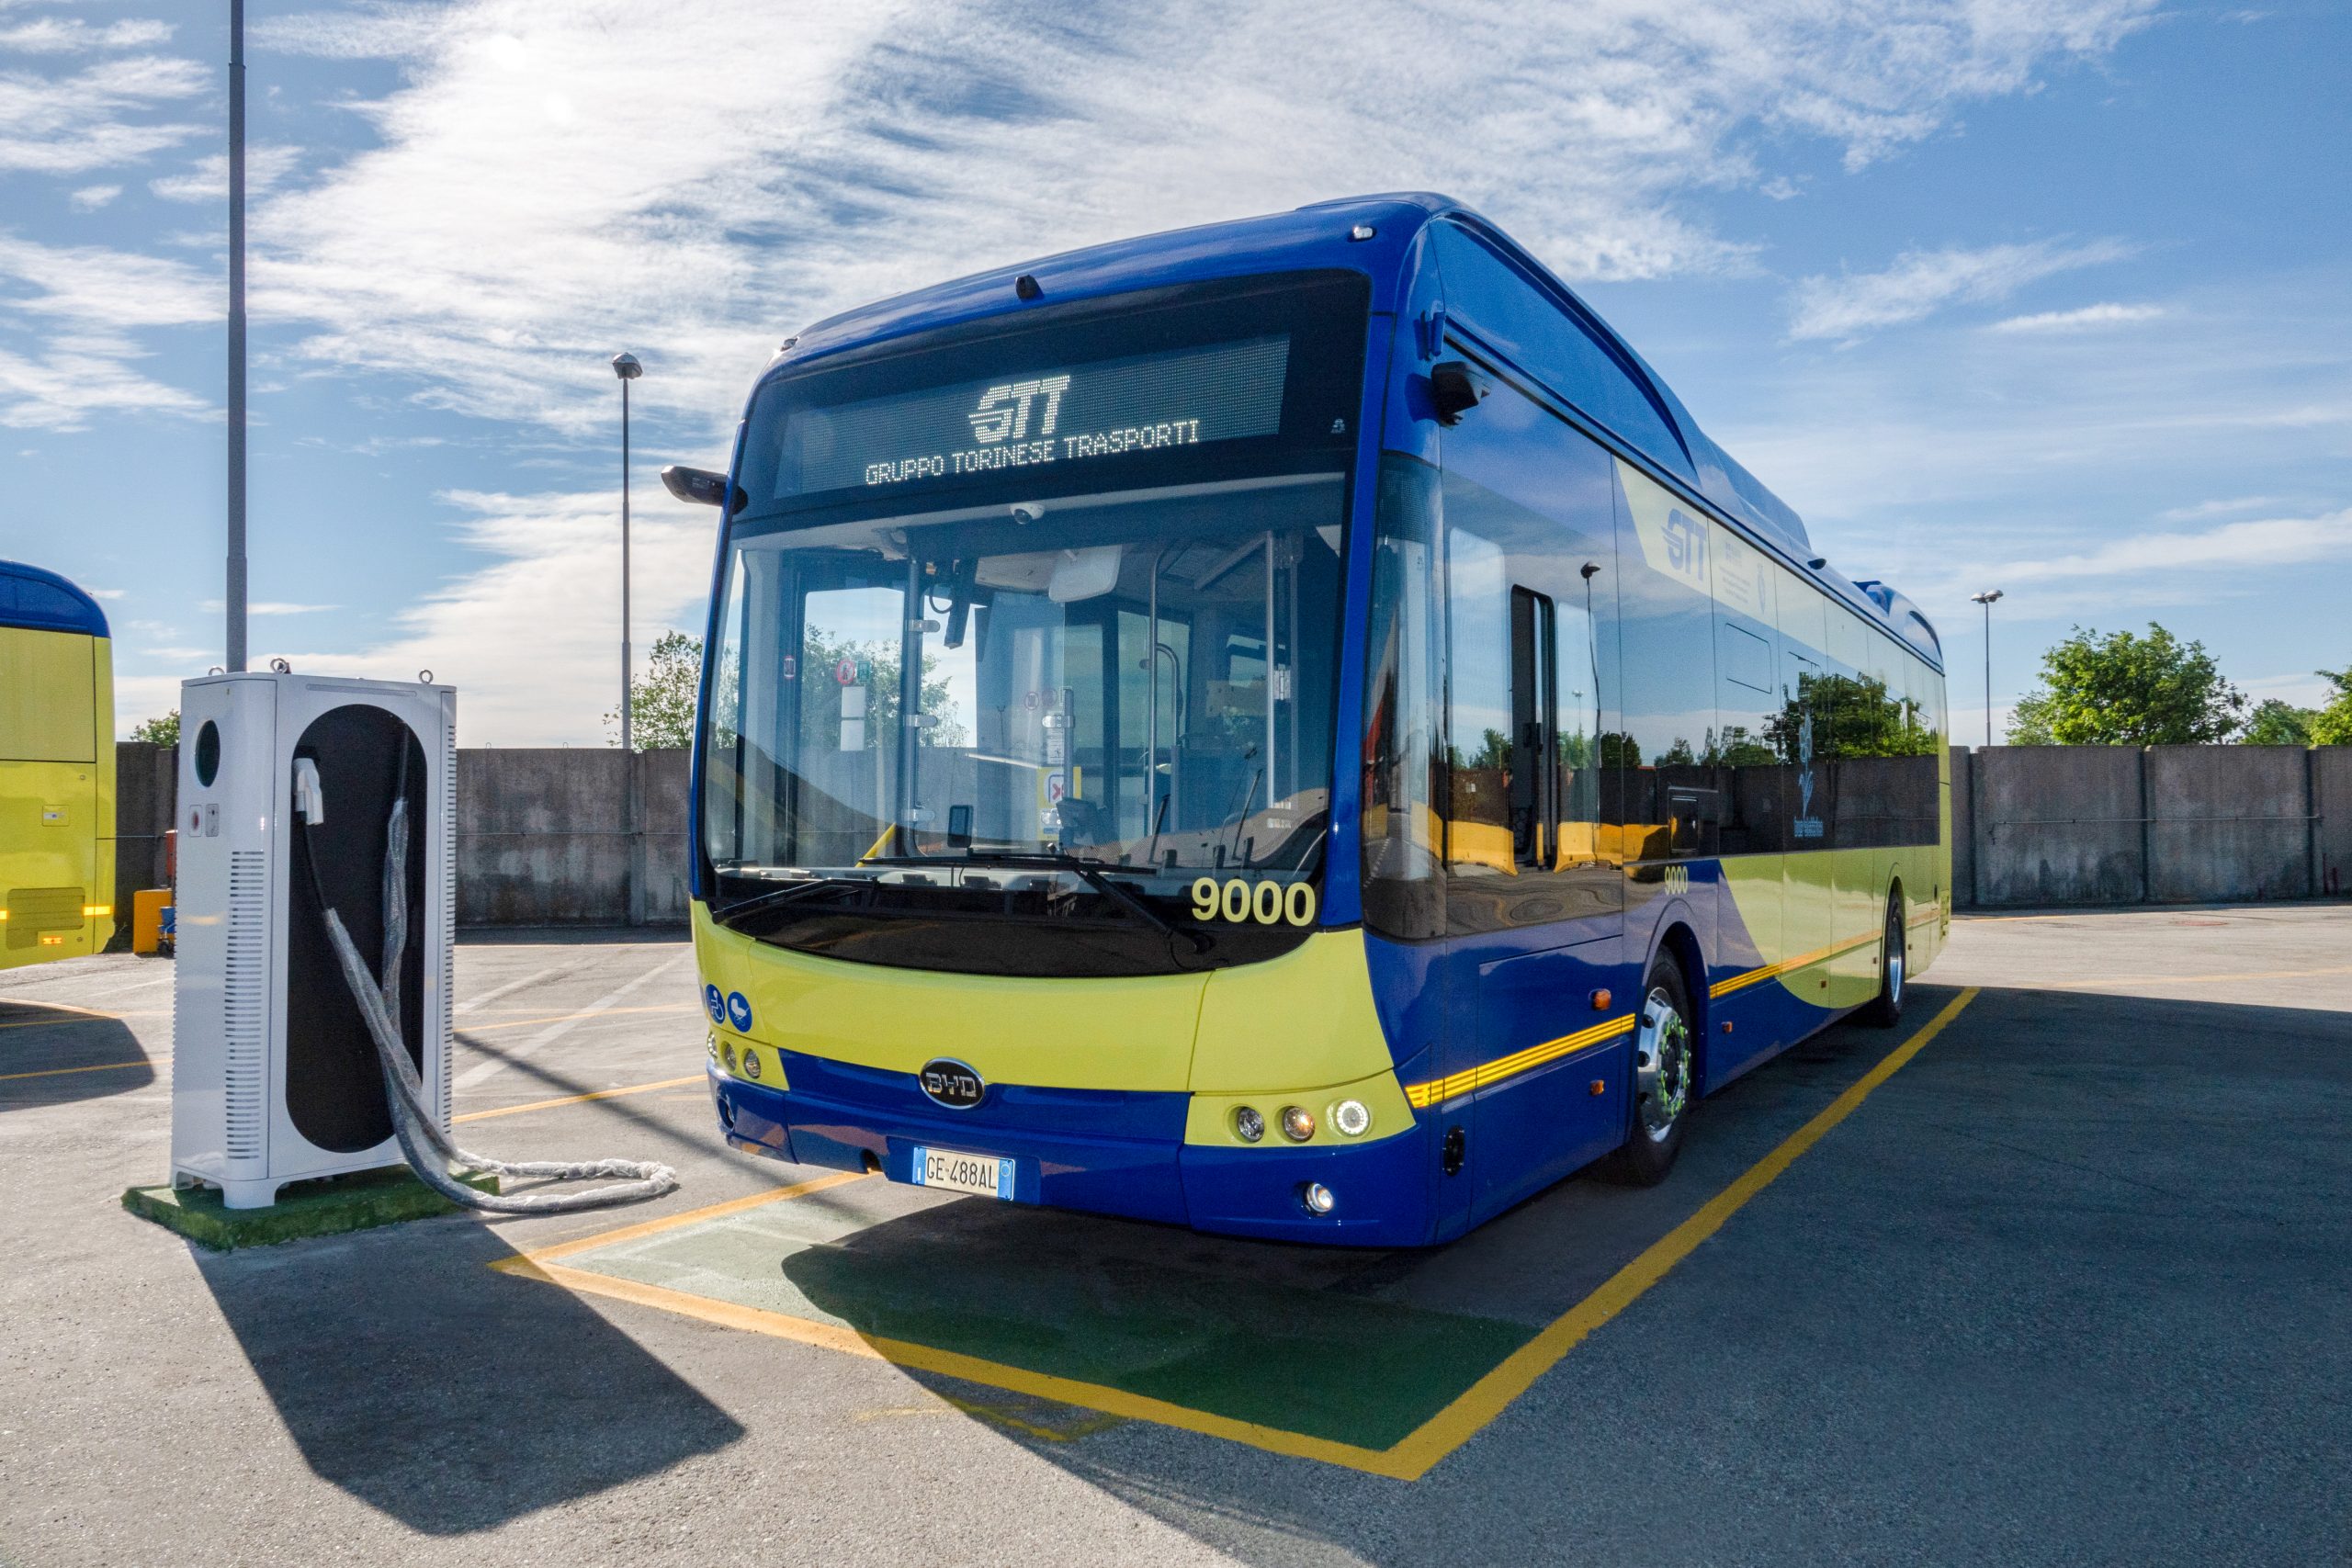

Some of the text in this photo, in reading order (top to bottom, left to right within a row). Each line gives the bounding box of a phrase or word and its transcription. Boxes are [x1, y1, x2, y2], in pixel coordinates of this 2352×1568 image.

[968, 376, 1069, 443] GTT
[865, 420, 1199, 485] GRUPPO TORINESE TRASPORTI
[1660, 508, 1706, 581] GTT
[1192, 877, 1316, 926] 9000
[1665, 866, 1688, 896] 9000
[926, 1072, 977, 1098] BYD
